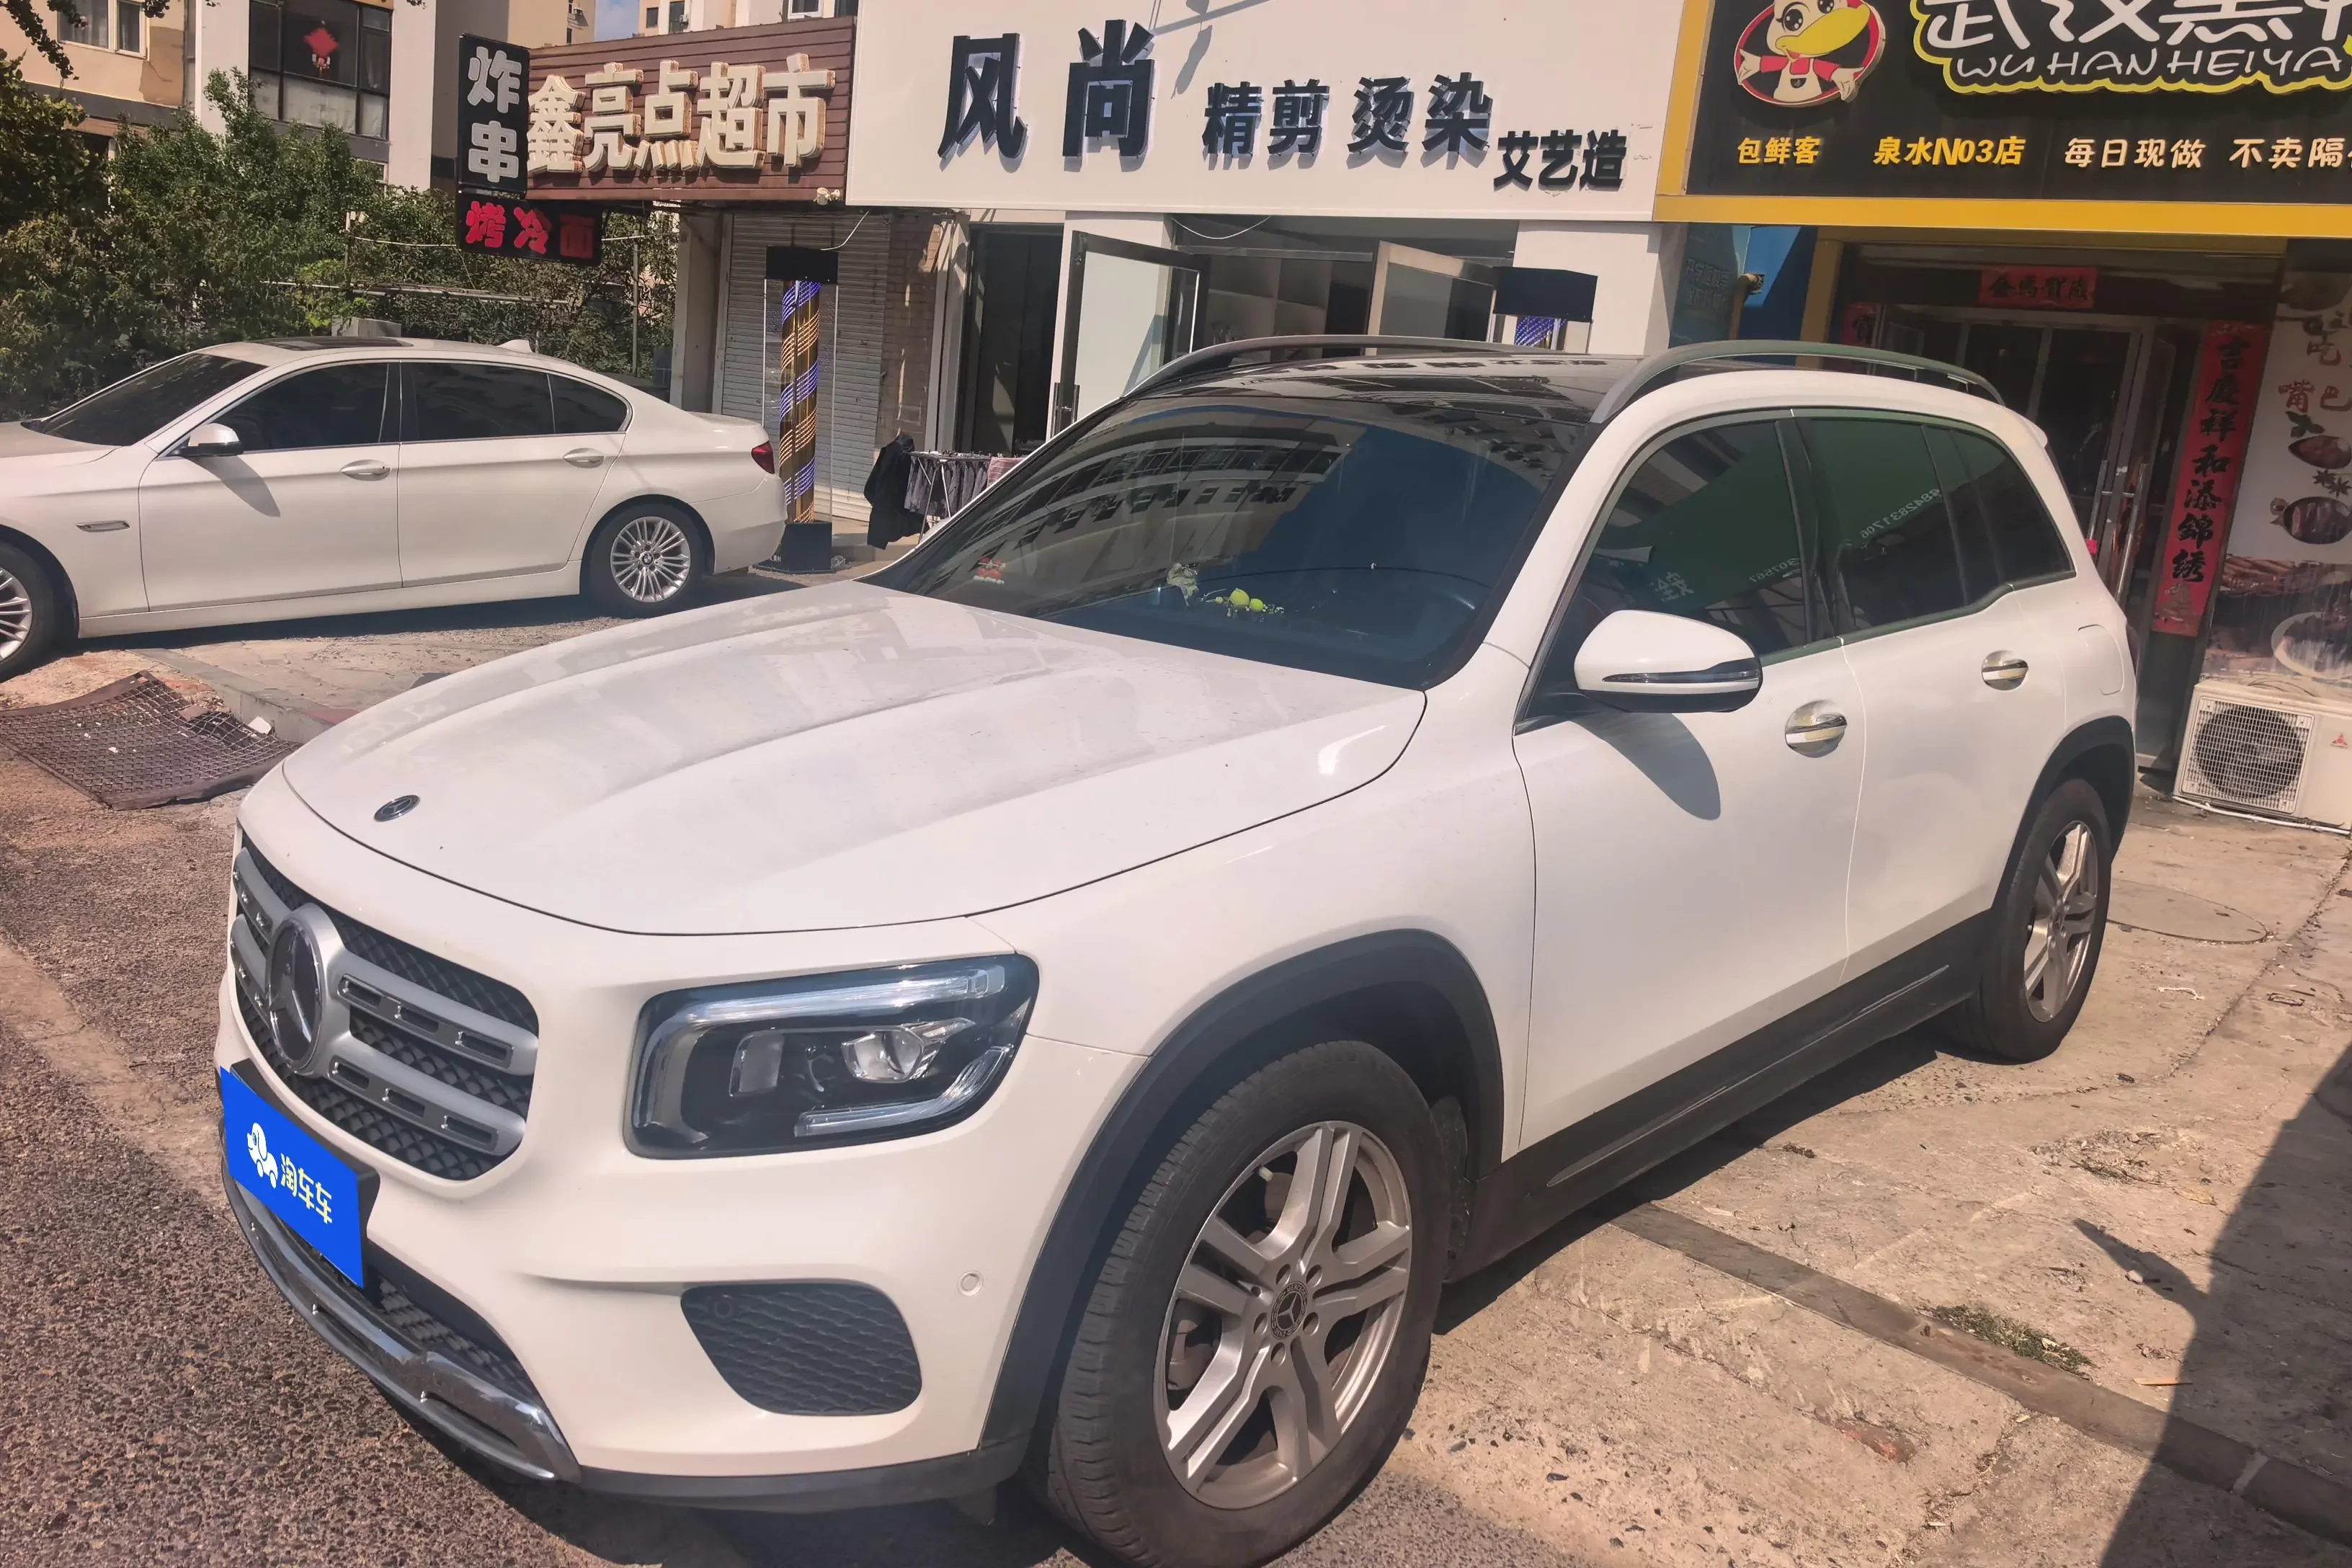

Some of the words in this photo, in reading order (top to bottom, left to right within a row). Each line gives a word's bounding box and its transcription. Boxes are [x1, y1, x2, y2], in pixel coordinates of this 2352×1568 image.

[467, 45, 522, 183] 炸串
[527, 53, 835, 173] 鑫亮点超市
[938, 19, 1155, 158] 风尚
[1203, 72, 1493, 155] 精剪烫染
[1737, 136, 1820, 166] 包鲜客
[2065, 138, 2206, 169] 每日现做
[2229, 137, 2352, 169] 不卖隔
[466, 200, 593, 259] 烤冷面
